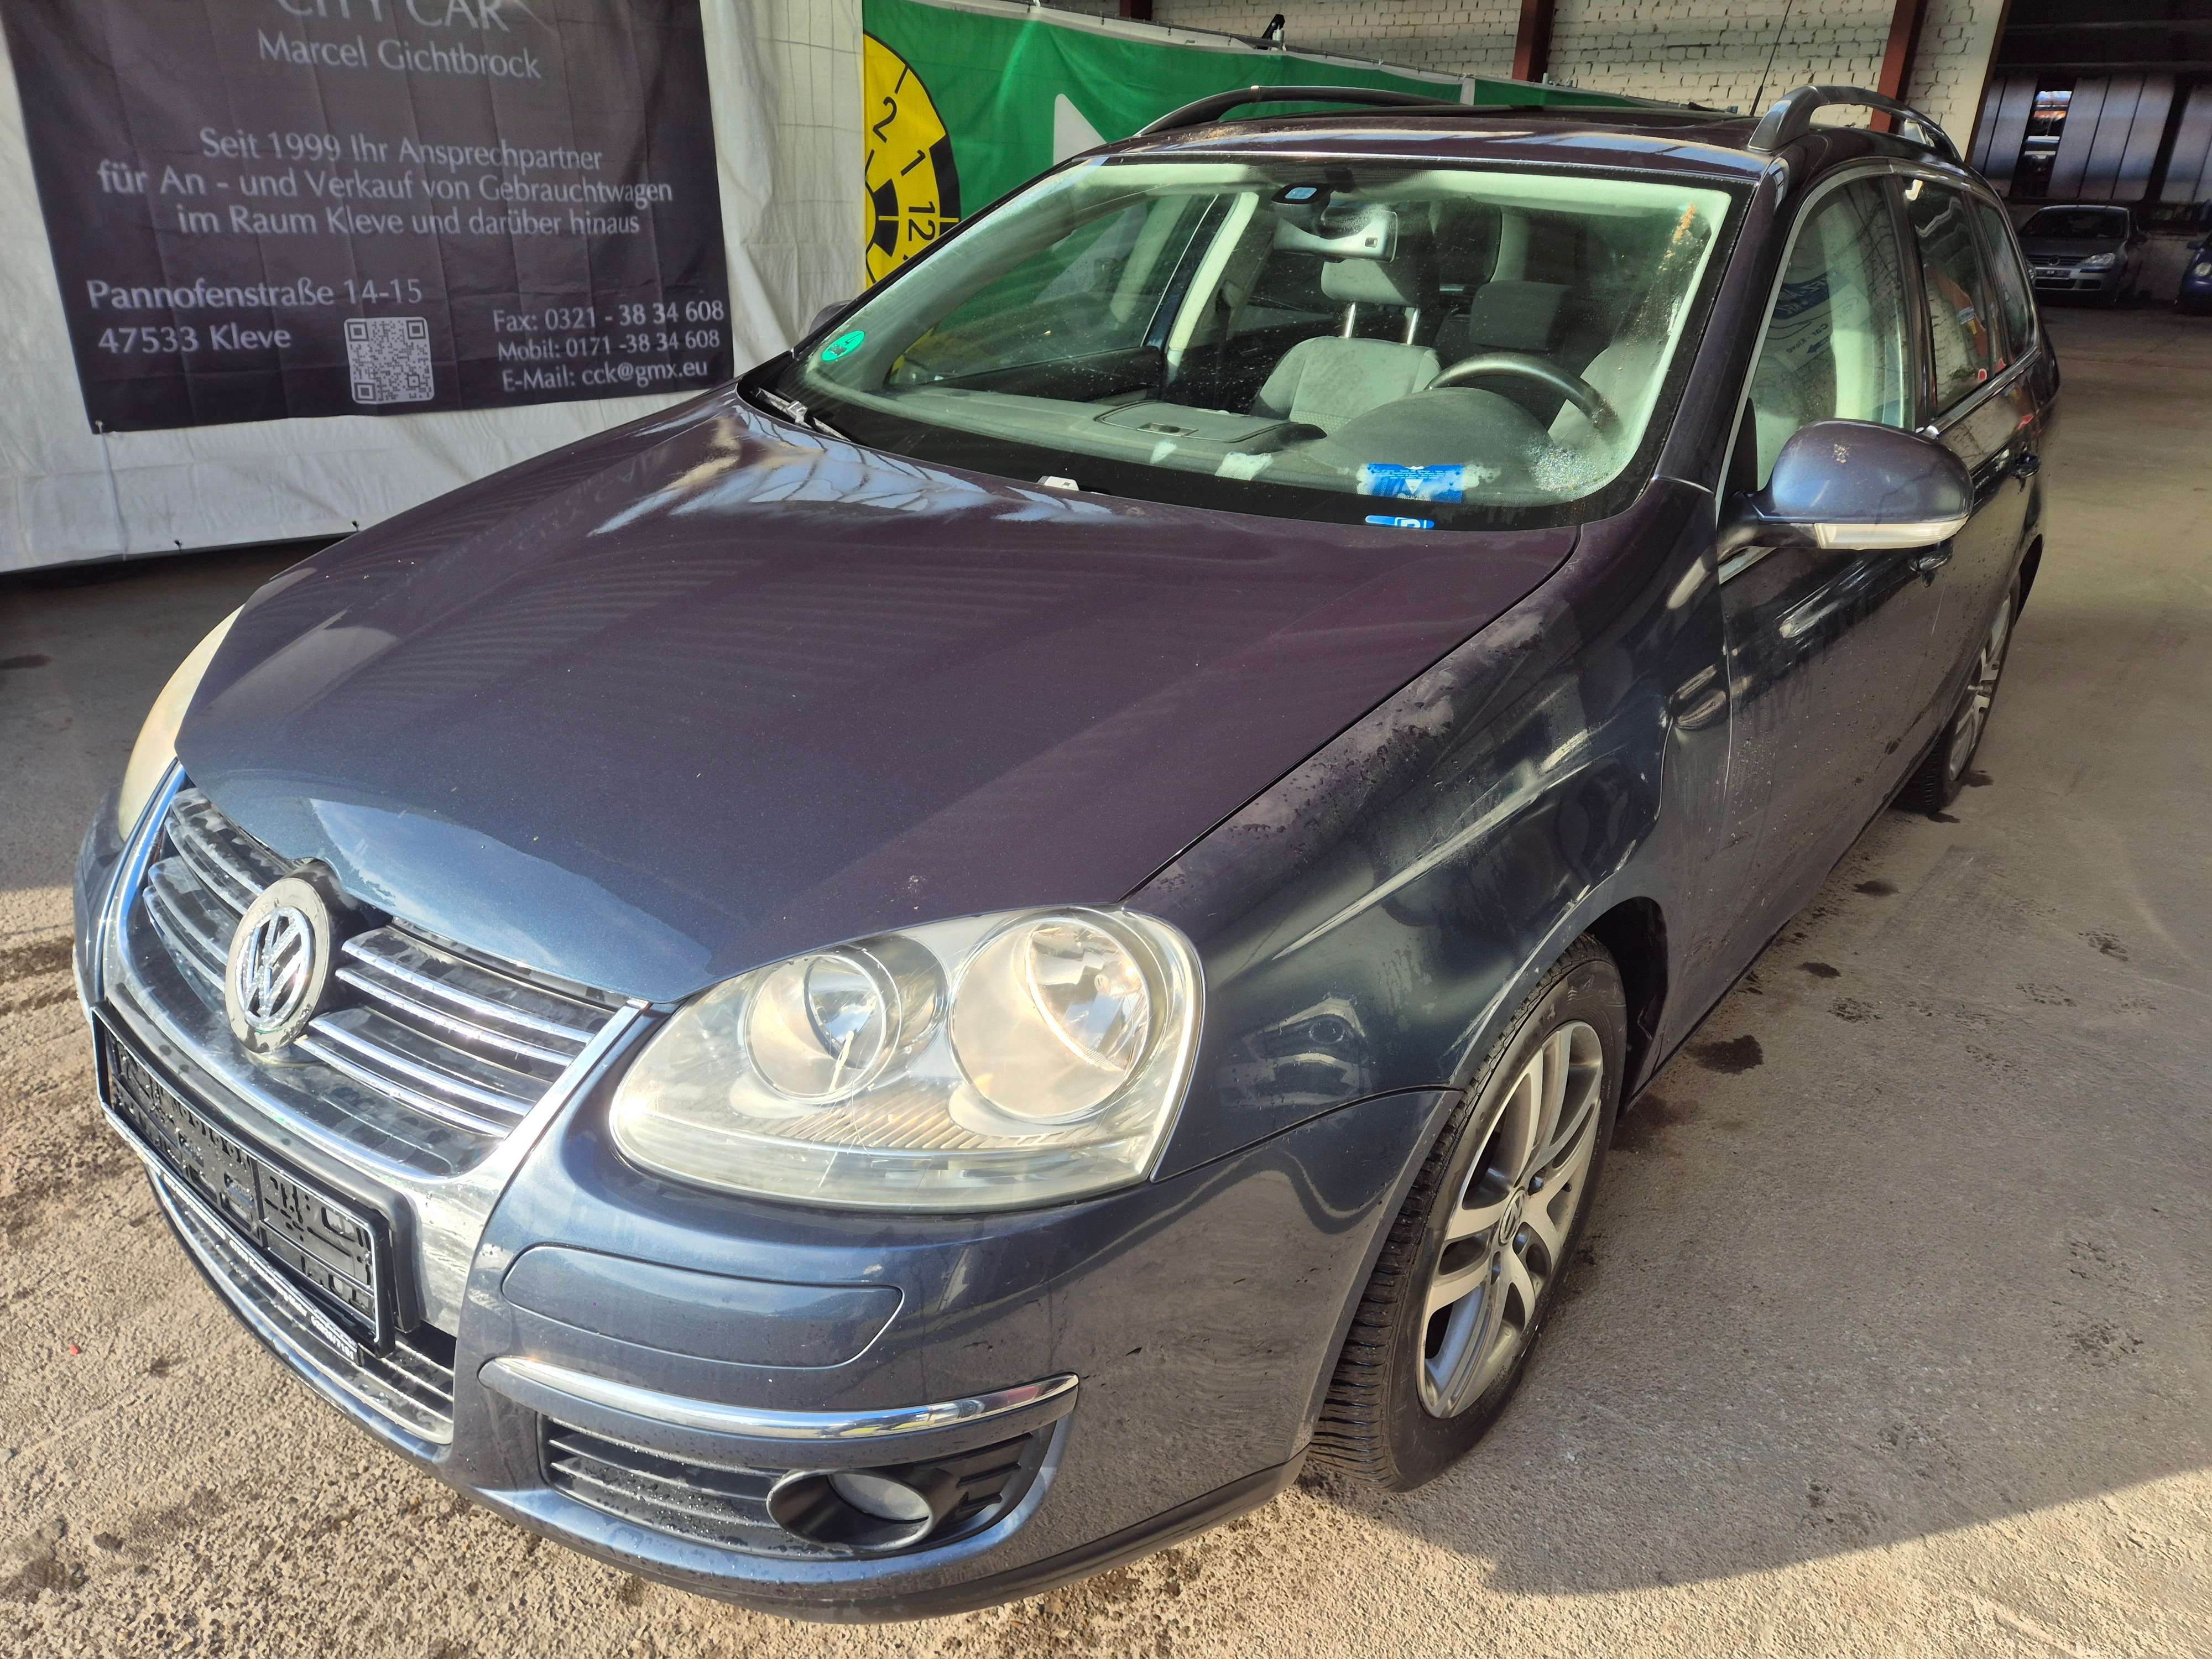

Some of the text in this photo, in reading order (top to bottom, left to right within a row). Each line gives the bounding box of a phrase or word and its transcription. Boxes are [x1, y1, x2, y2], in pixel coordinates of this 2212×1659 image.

[405, 0, 510, 32] CAR
[257, 29, 541, 79] Marcel Gichtbrock
[872, 96, 897, 143] 2
[200, 127, 602, 175] Seit 1999 Ihr Ansprechpartner
[900, 149, 926, 177] 1
[97, 159, 149, 194] für
[160, 165, 207, 195] An
[239, 167, 298, 196] und
[304, 168, 414, 199] Verkauf
[420, 179, 471, 199] von
[479, 174, 672, 210] Gebrauchtwagen
[176, 203, 640, 234] im Raum Kleve und darüber hinaus
[908, 201, 936, 242] 12
[86, 276, 422, 310] Pannofenstraße 14-15
[493, 309, 538, 332] Fax:
[545, 306, 596, 330] 0321
[618, 303, 646, 326] 38
[653, 301, 679, 325] 34
[685, 300, 724, 322] 608
[98, 322, 291, 354] 47533 Kleve
[498, 337, 561, 362] Mobil:
[566, 335, 611, 358] 0171
[656, 332, 679, 352] 34
[685, 329, 720, 349] 608
[502, 361, 708, 392] E-Mail: cck@gmx.eu
